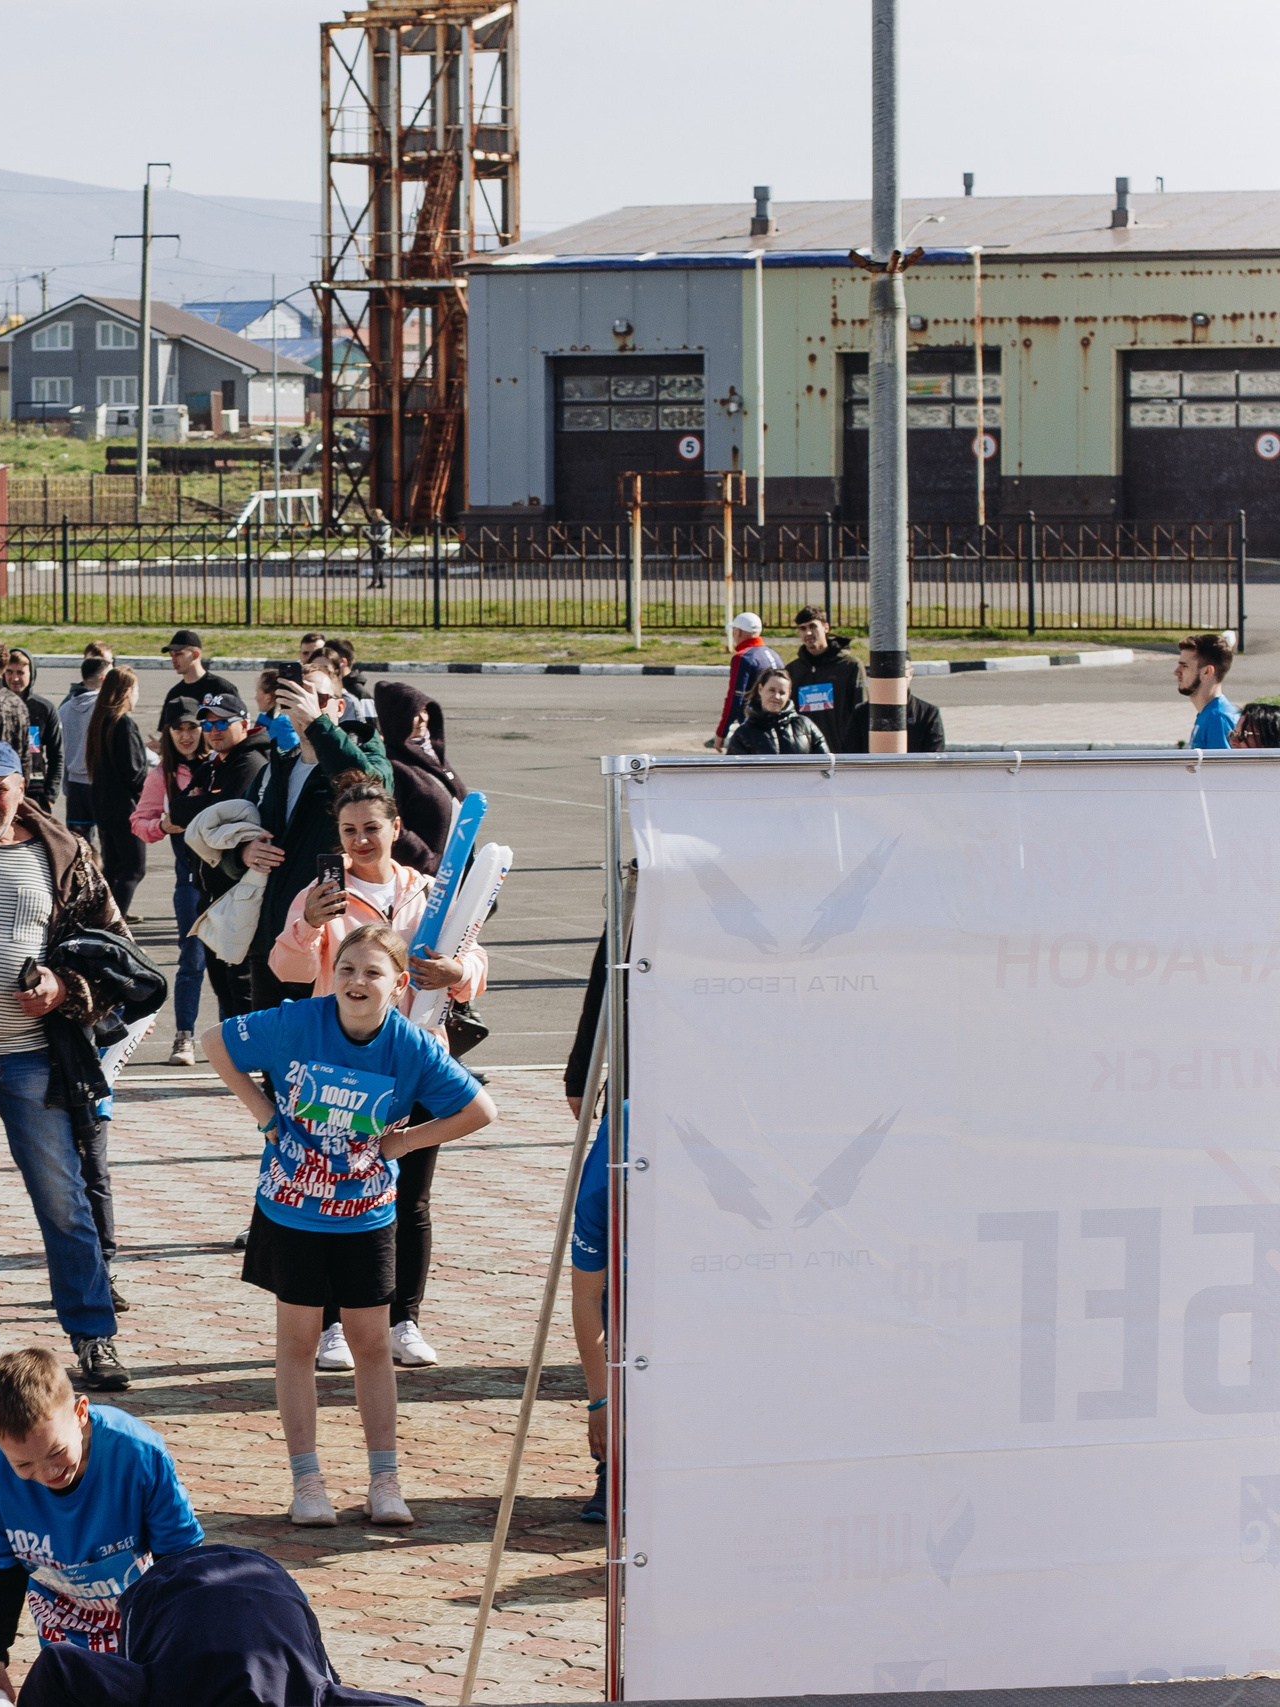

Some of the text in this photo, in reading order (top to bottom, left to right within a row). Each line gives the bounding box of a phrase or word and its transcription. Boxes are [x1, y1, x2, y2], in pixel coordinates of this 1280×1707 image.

[686, 441, 695, 454] 5
[1264, 440, 1274, 453] 3
[319, 1085, 369, 1111] 10017
[327, 1107, 354, 1129] 1КМ
[280, 1132, 332, 1172] #ЗАБЕГ
